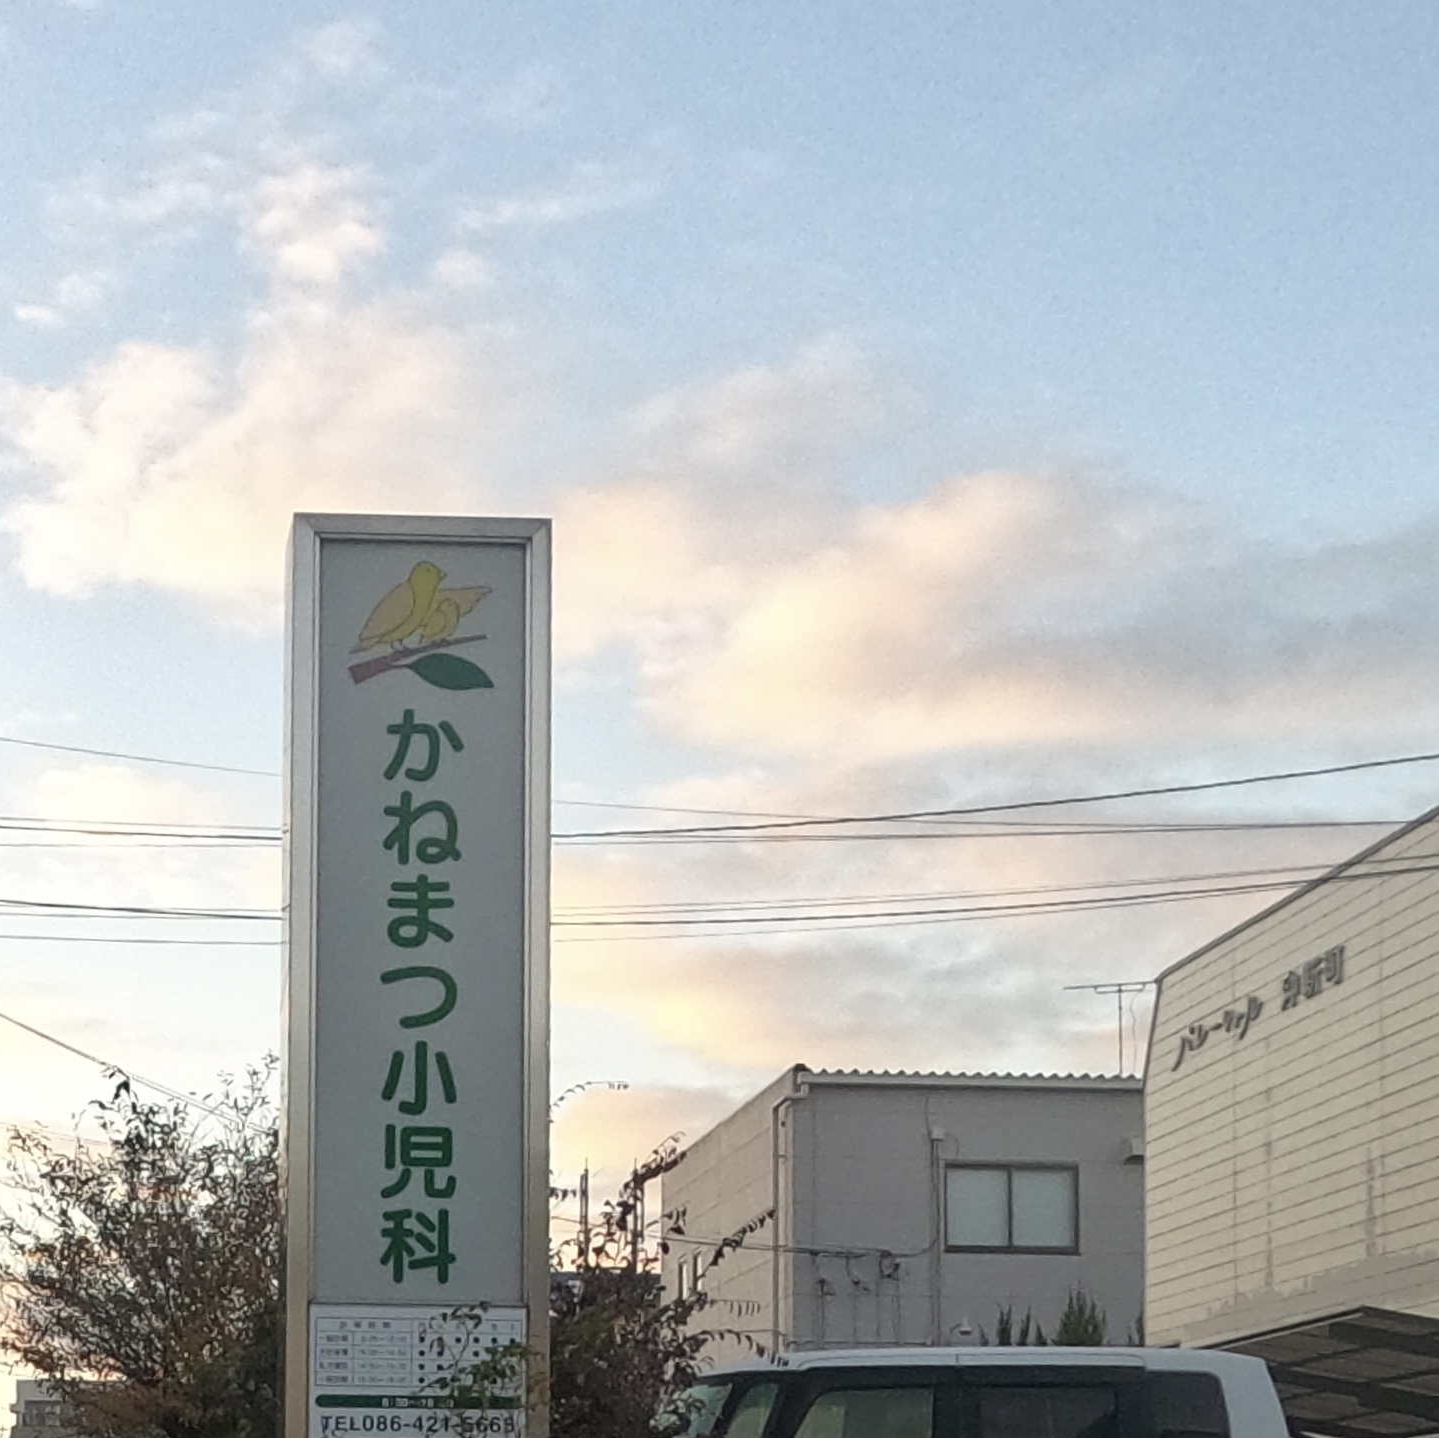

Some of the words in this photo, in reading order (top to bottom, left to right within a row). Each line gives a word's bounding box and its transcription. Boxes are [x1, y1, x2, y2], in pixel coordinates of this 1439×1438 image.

[380, 708, 464, 1284] かねまつ小児科
